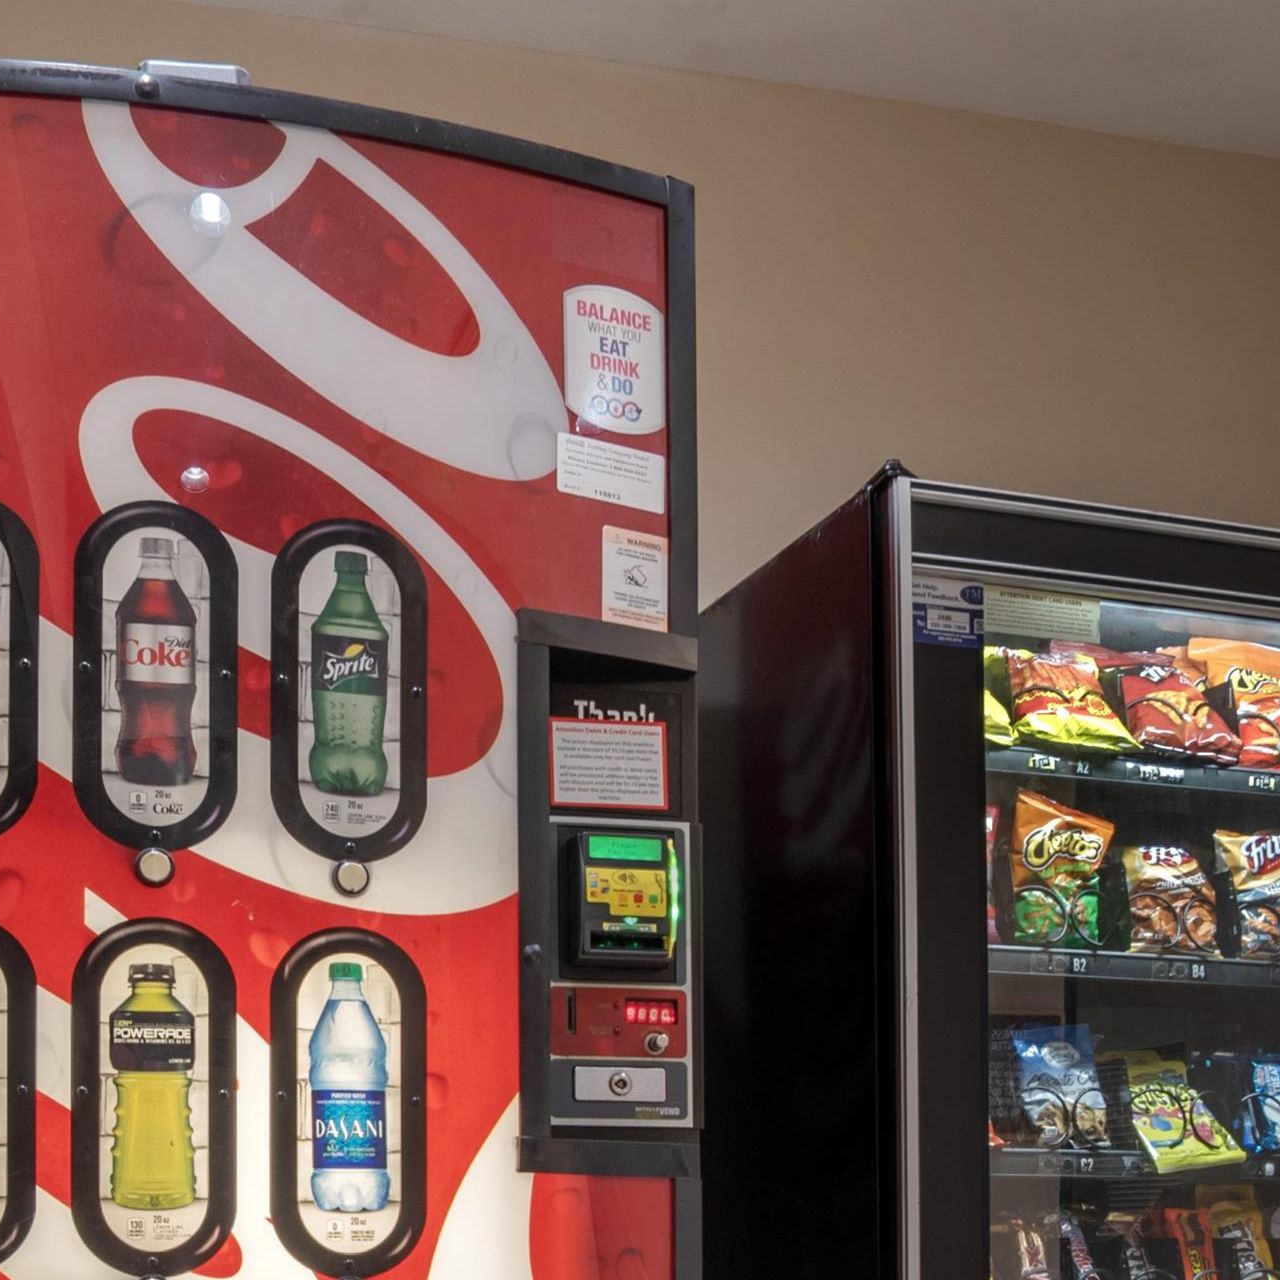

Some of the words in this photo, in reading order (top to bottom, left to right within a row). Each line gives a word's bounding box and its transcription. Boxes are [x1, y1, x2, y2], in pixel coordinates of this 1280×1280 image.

[577, 300, 651, 331] BALANCE
[588, 320, 617, 337] WHAT
[621, 328, 641, 343] YOU
[600, 337, 628, 357] EAT
[590, 353, 640, 379] DRINK
[597, 373, 608, 390] &
[612, 376, 633, 395] DO
[627, 538, 661, 551] WARNING
[120, 638, 192, 668] Coke
[324, 652, 375, 681] Sprite
[155, 790, 164, 798] 20
[325, 804, 338, 812] 240
[348, 800, 356, 809] 20
[1023, 828, 1103, 870] Cheetos
[1073, 958, 1086, 972] B2
[1192, 964, 1205, 979] B4
[113, 1028, 192, 1039] POWERADE
[316, 1113, 383, 1140] DASANI
[1081, 1158, 1094, 1172] C2
[130, 1220, 143, 1229] 130
[153, 1215, 162, 1223] 20
[350, 1217, 359, 1225] 20
